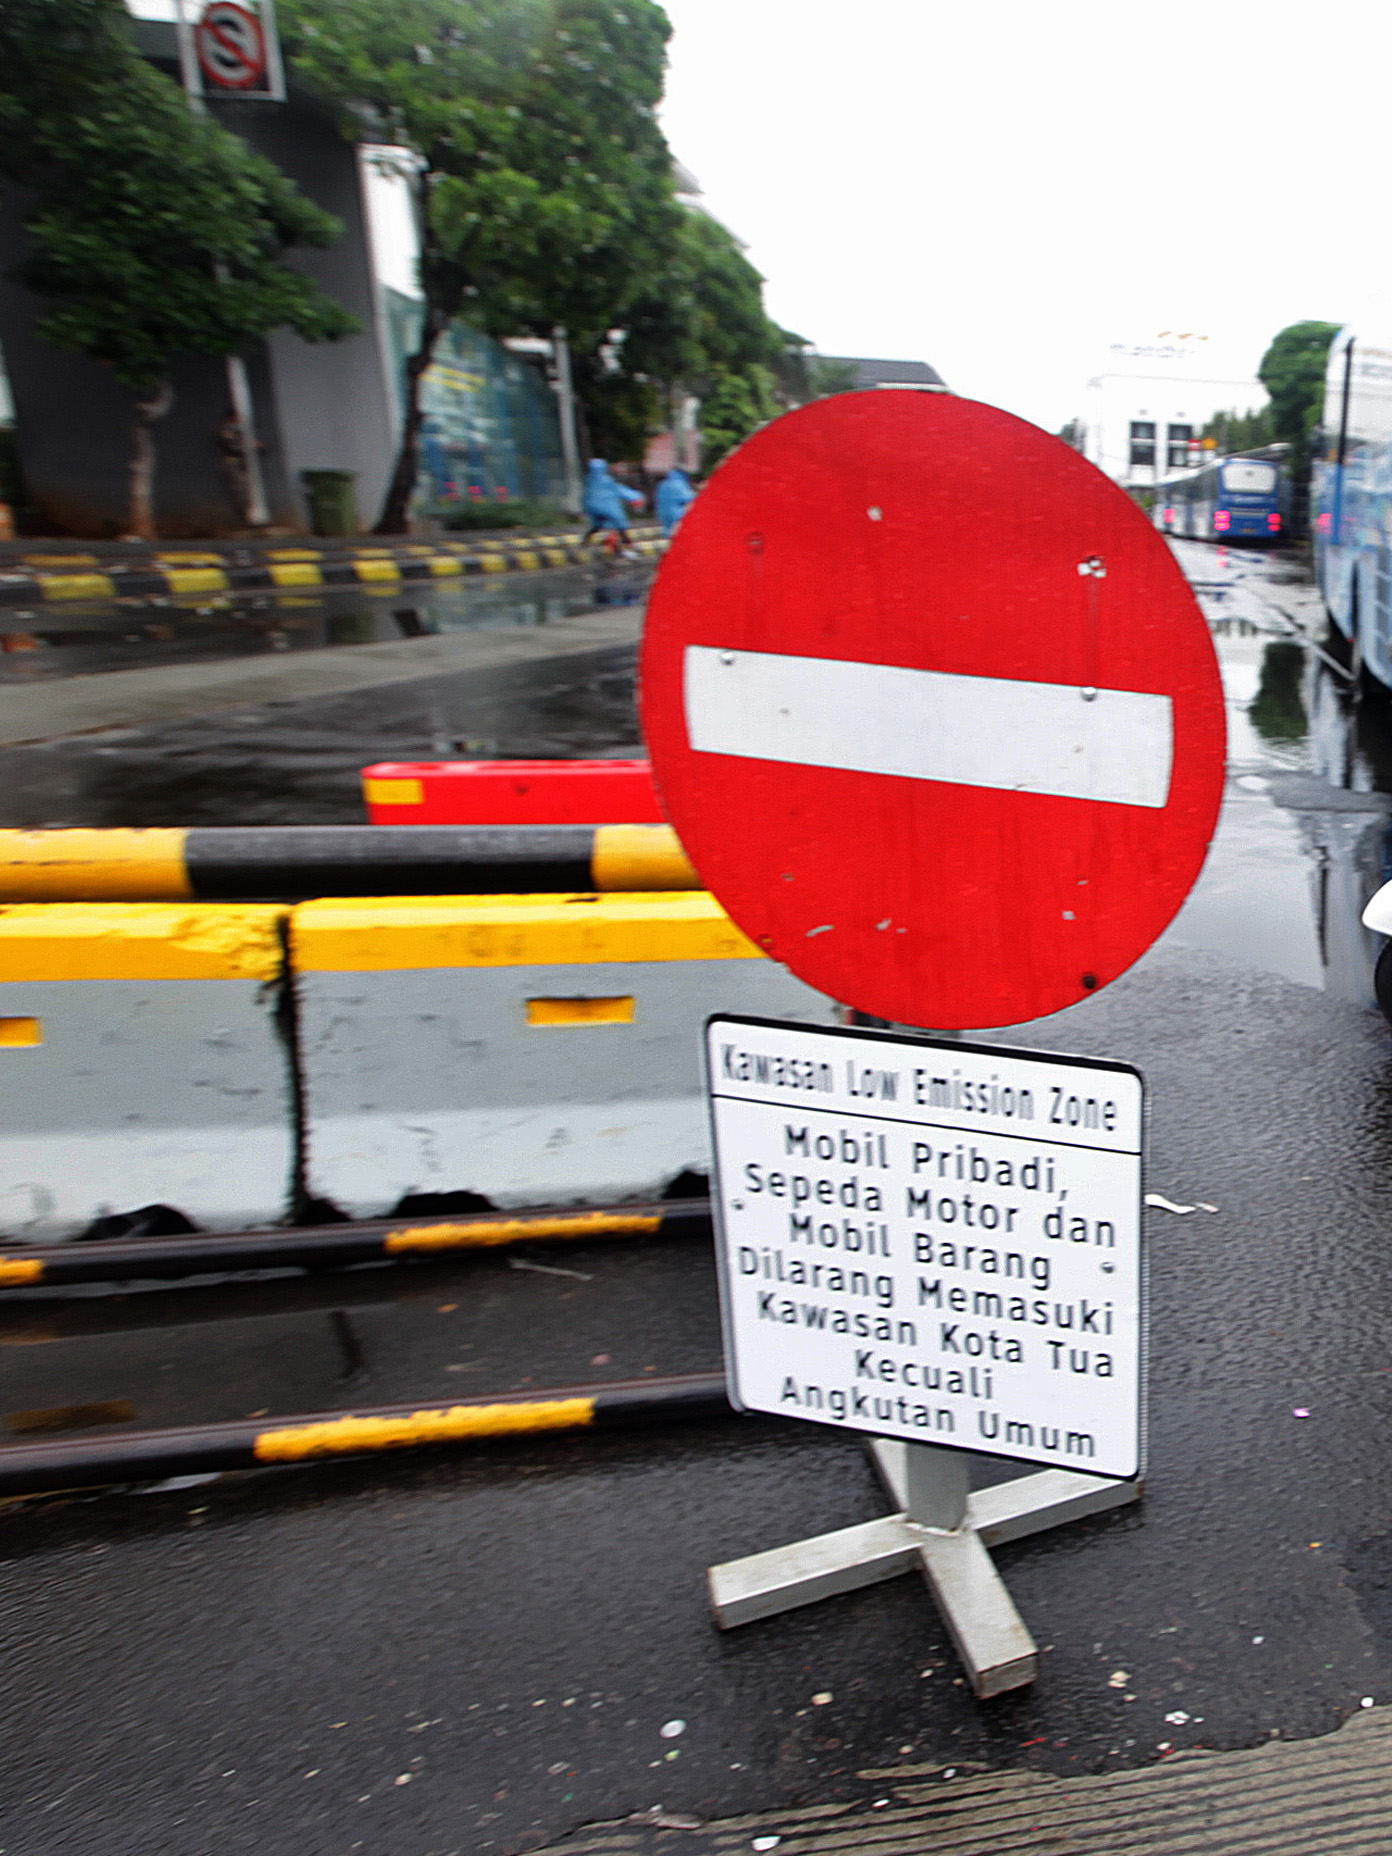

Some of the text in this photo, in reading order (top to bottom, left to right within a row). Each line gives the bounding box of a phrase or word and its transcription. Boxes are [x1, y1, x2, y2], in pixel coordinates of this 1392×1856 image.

[721, 1044, 1117, 1132] Kawasan Low Emission Zone
[785, 1125, 1068, 1201] Mobil Pribadi,
[745, 1163, 1116, 1248] Sepeda Motor dan
[738, 1246, 1113, 1335] Dilarang Memasuki
[789, 1212, 1051, 1291] Mobil Barang
[757, 1291, 1114, 1378] Kawasan Kota Tua
[855, 1350, 993, 1400] Kecuali
[780, 1376, 1095, 1458] Angkutan Umum
